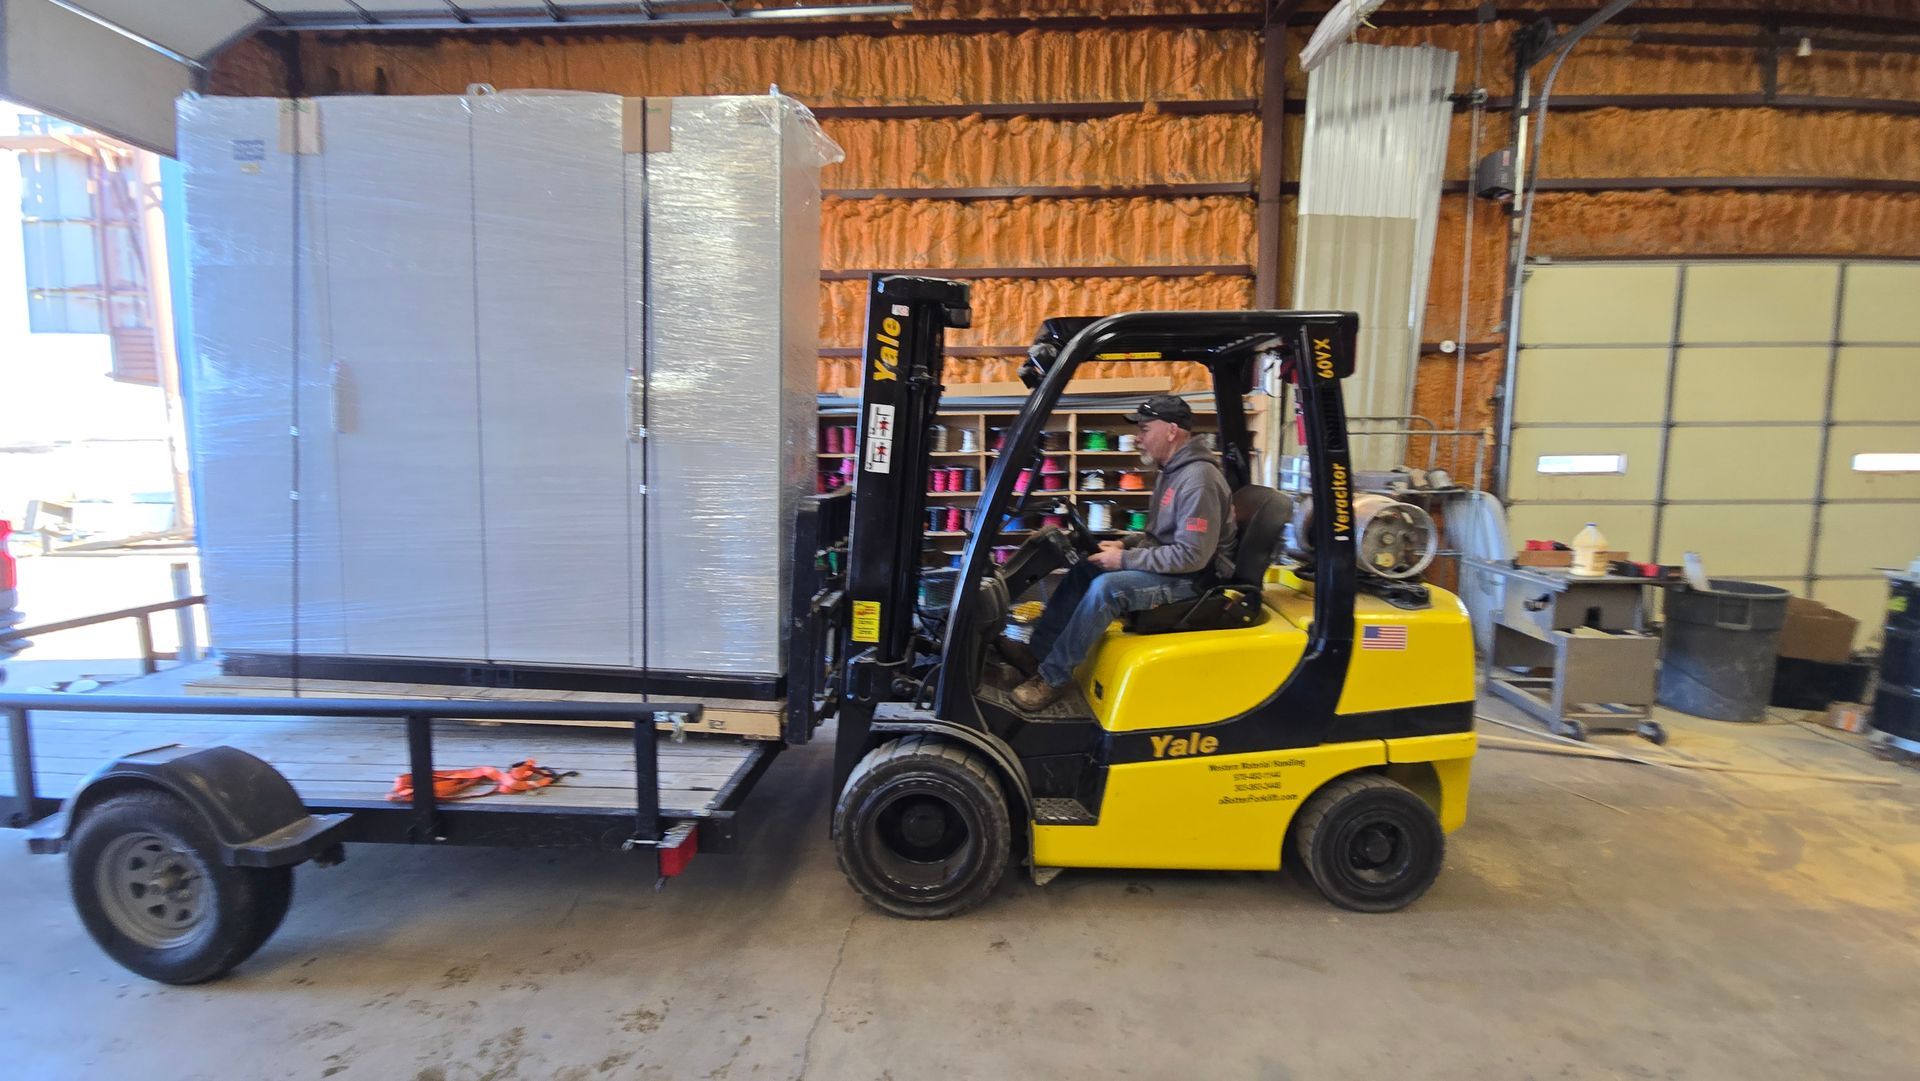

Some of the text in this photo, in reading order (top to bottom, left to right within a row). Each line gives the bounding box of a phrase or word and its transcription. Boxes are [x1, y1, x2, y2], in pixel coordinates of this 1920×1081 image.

[872, 317, 902, 382] Yale
[1313, 338, 1335, 379] 60VX
[1331, 463, 1351, 533] Veracitor
[1150, 731, 1219, 758] Yale
